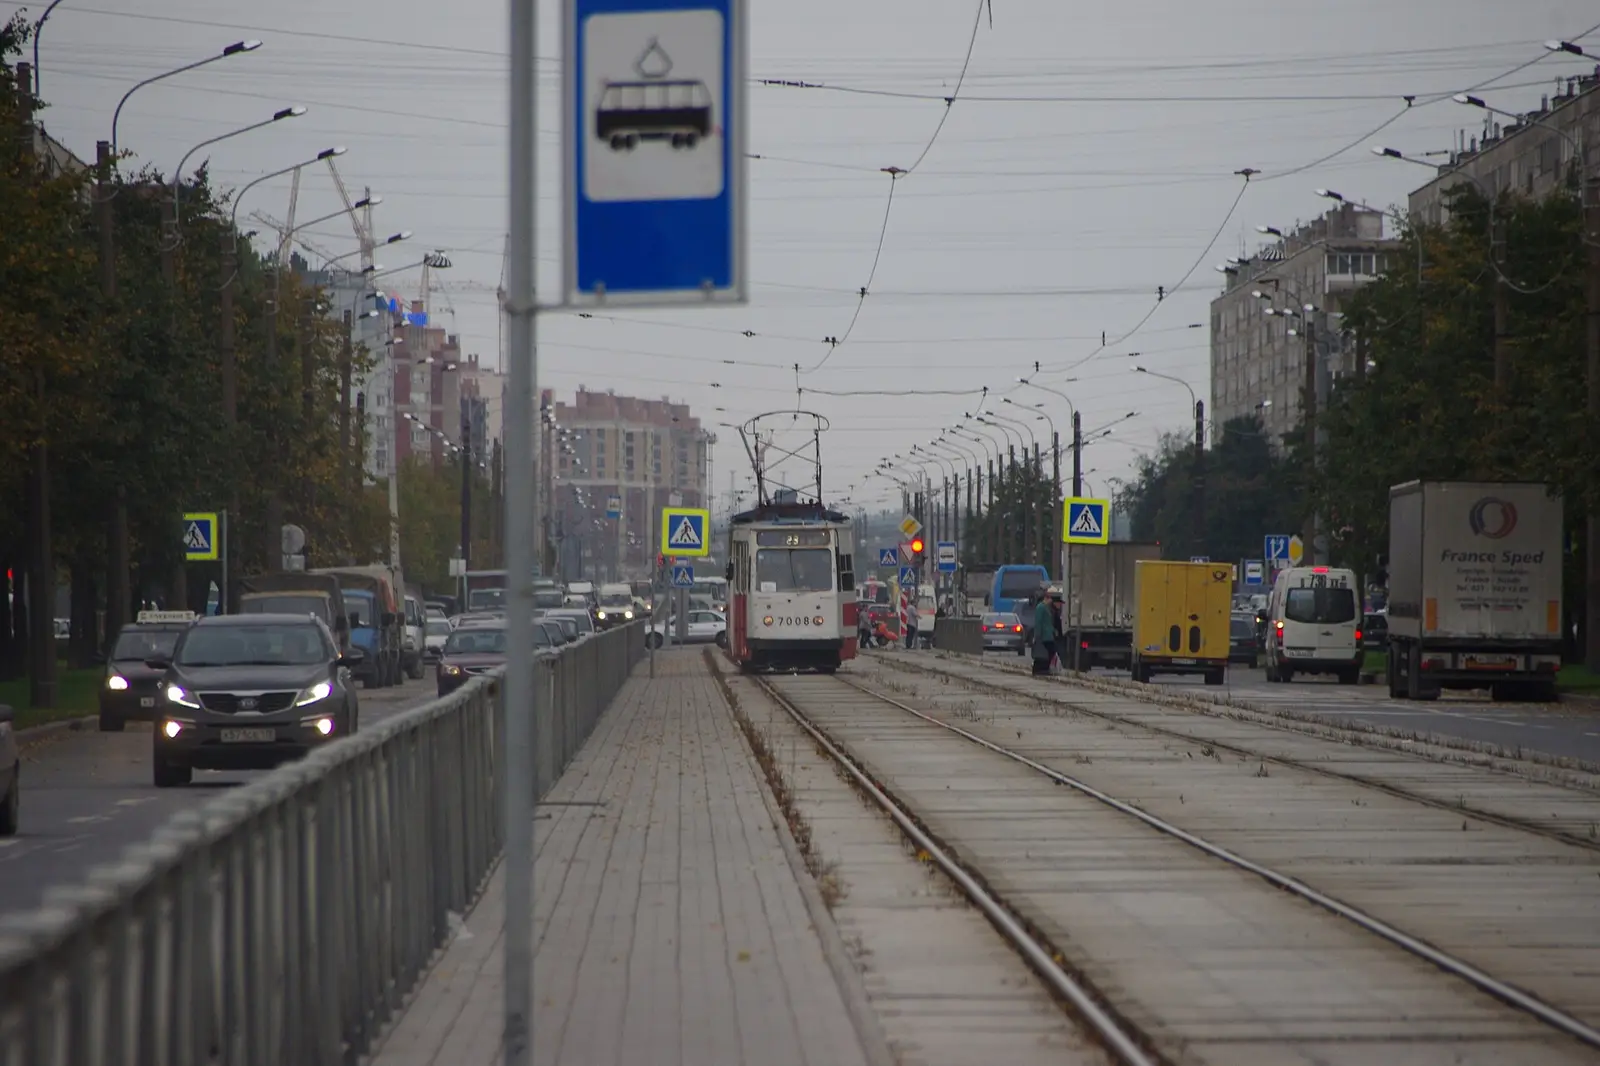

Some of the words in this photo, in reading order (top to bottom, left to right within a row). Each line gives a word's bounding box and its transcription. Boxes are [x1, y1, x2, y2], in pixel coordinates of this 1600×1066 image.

[1440, 549, 1497, 563] France
[1501, 550, 1545, 567] Sped
[777, 616, 811, 626] 7008
